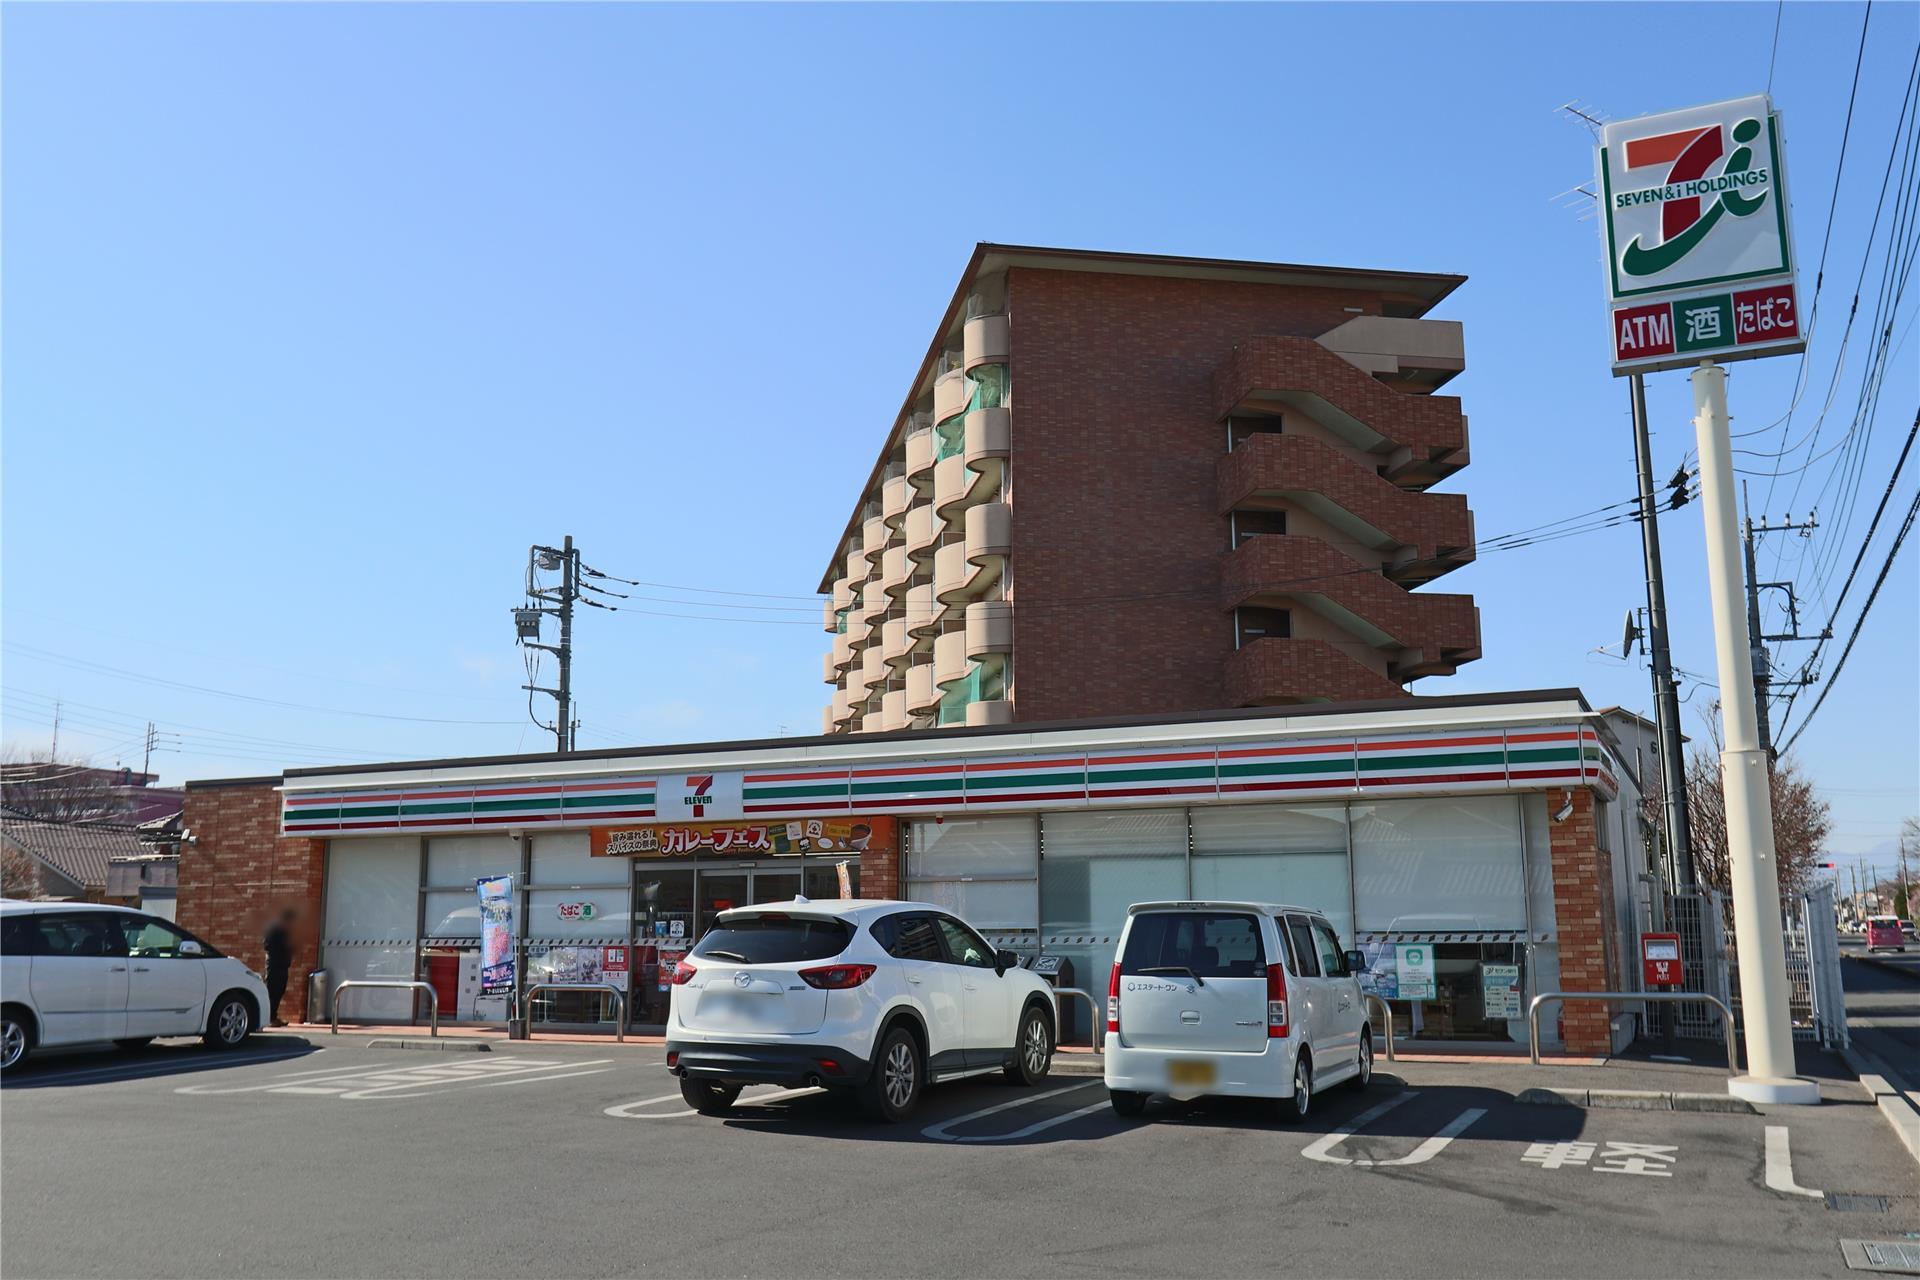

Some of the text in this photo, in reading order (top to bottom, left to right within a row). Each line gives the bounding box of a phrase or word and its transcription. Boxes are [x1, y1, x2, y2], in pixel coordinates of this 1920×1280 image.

[1686, 169, 1768, 198] HOLDINGS
[1619, 297, 1794, 351] ATM 酒 たばこ
[608, 839, 657, 852] スパイスの祭典
[661, 827, 770, 853] カレーフェス
[561, 905, 580, 916] たばこ
